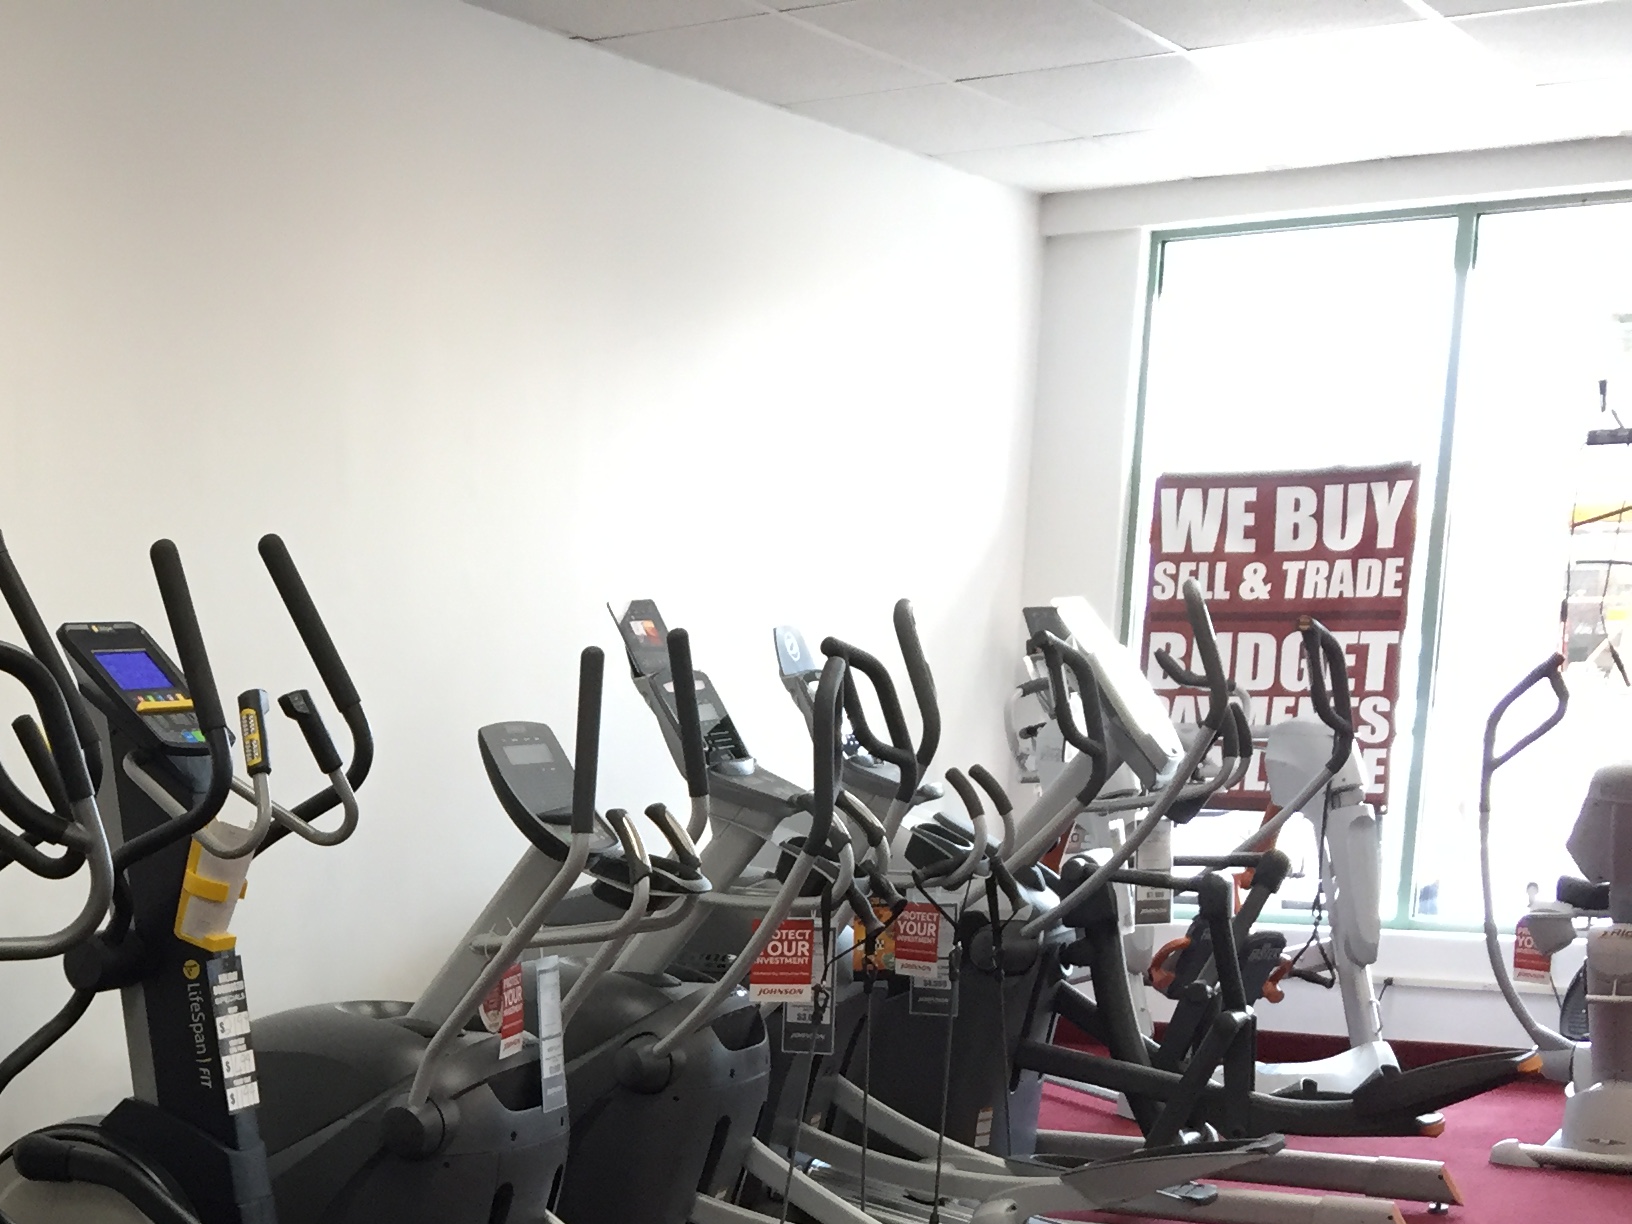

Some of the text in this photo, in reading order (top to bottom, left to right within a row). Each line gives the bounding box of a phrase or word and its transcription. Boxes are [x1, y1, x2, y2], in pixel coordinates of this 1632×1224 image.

[1161, 480, 1413, 553] WE BUY
[1152, 557, 1404, 600] SELL & TRADE
[897, 920, 937, 937] YOUR
[767, 940, 810, 956] OUR
[503, 985, 523, 1007] YOUR
[757, 986, 804, 996] JOHNSON
[187, 983, 213, 1089] LifeSpan FIT
